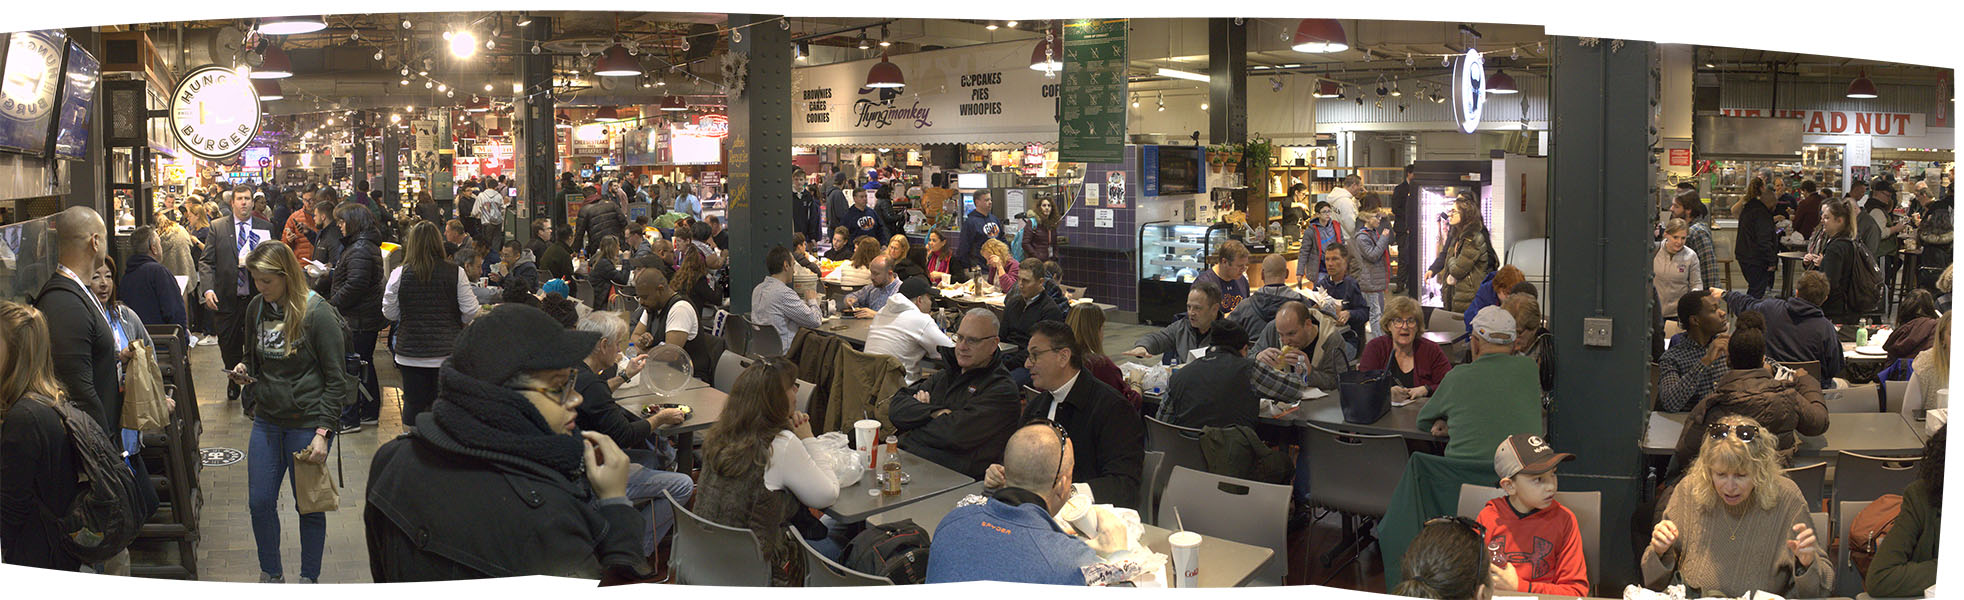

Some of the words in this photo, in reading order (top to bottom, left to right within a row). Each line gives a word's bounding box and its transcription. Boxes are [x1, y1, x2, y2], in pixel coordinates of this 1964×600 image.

[961, 72, 1002, 87] CUPCAKES
[181, 75, 232, 104] HUNG
[803, 88, 832, 100] BROWNIES
[971, 88, 989, 101] PIES
[809, 101, 827, 111] CAKES
[960, 102, 1002, 116] WHOOPIES
[806, 112, 830, 123] COOKIES
[1855, 112, 1911, 136] NUT
[181, 123, 250, 151] BURGER
[981, 521, 1012, 535] SPYDER
